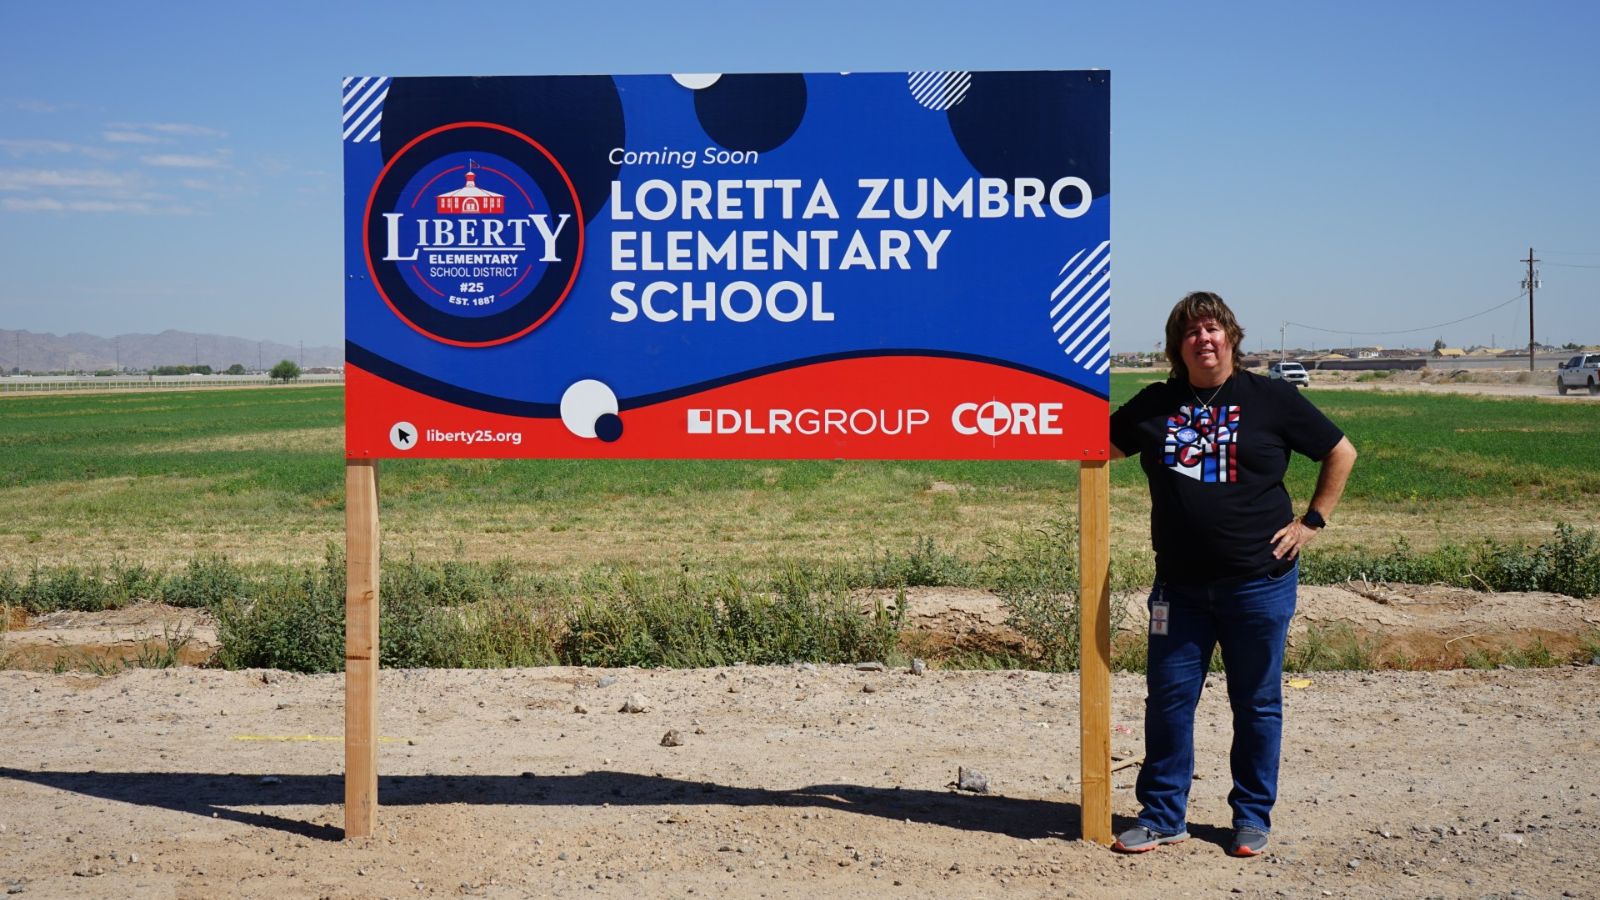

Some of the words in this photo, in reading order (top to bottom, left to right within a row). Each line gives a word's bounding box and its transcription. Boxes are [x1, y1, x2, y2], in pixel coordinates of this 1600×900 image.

[608, 146, 697, 169] Coming
[702, 146, 759, 165] Soon
[611, 178, 840, 221] LORETTA
[856, 176, 1093, 220] ZUMBRO
[382, 212, 571, 263] LIBERTY
[429, 254, 519, 265] ELEMENTARY
[611, 229, 952, 271] ELEMENTARY
[429, 266, 471, 278] SCHOOL
[472, 266, 518, 278] DISTRICT
[459, 282, 485, 293] #25
[448, 294, 470, 306] EST.
[472, 294, 495, 306] 1887
[610, 280, 835, 323] SCHOOL
[951, 400, 1063, 437] CORE
[426, 428, 522, 446] liberty25.org
